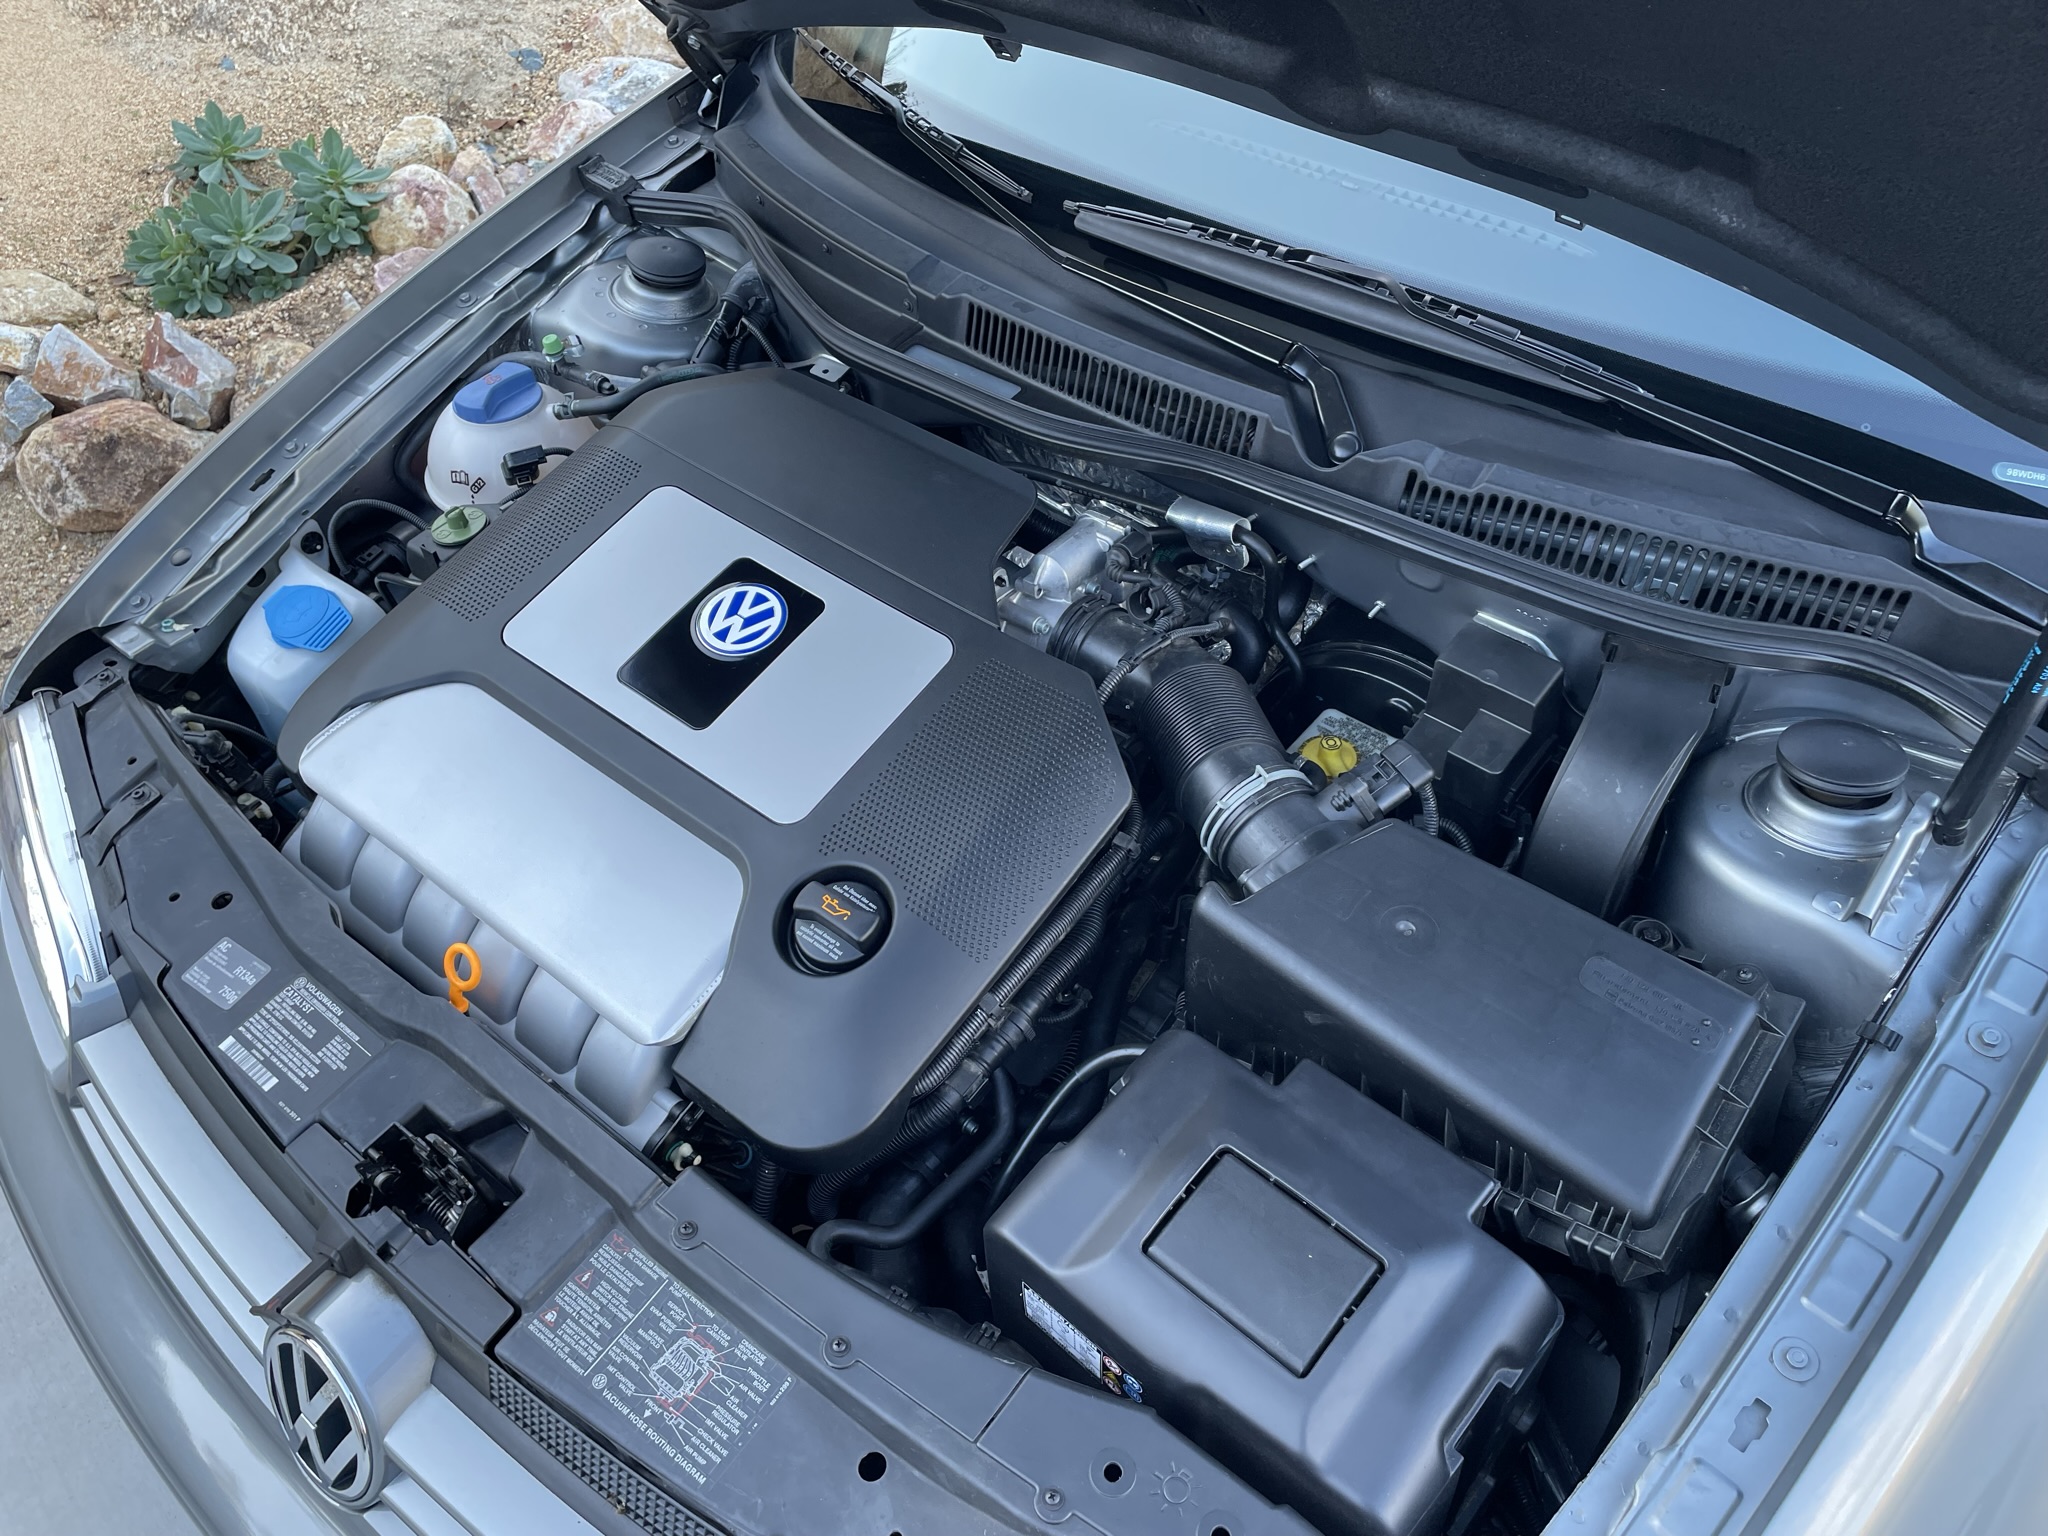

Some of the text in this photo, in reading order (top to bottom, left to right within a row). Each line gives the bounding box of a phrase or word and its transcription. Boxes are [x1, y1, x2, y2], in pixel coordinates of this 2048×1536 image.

[2006, 467, 2048, 481] 9BWDH6
[471, 478, 485, 493] G12
[697, 582, 788, 657] VW
[217, 940, 232, 952] AC
[232, 965, 256, 985] R134a
[218, 984, 238, 1004] 750g
[282, 986, 314, 1013] CATALYST
[305, 982, 343, 1016] VOLKSWAGEN
[589, 1257, 602, 1269] POUR
[598, 1248, 625, 1272] REMPLISSAGE
[626, 1252, 659, 1280] OIL CAN DAMAGE
[630, 1247, 668, 1279] OVERFILLED ENGINE
[600, 1279, 612, 1291] HIGH
[609, 1265, 634, 1287] DANGEREUX
[562, 1285, 577, 1299] HAUTE
[567, 1281, 585, 1298] IGNITION
[668, 1285, 682, 1297] PUMP
[672, 1281, 715, 1318] TO LEAK DETECTION
[554, 1295, 573, 1313] TOUCHER
[558, 1290, 599, 1328] LE MOTEUR AVANT DE
[591, 1289, 628, 1322] BEFORE TOUCHING
[595, 1284, 634, 1319] SWITCH OFF ENGINE
[667, 1300, 686, 1318] SERVICE
[649, 1305, 677, 1329] EVAP PURGE
[669, 1310, 683, 1322] PORT
[532, 1318, 570, 1353] RADIATEUR PEUT SE
[561, 1323, 575, 1336] START
[578, 1339, 588, 1348] ANY
[565, 1318, 603, 1351] RADIATOR FAN MAY
[637, 1328, 660, 1348] MANIFOLD
[647, 1329, 664, 1344] INTAKE
[658, 1321, 673, 1334] VALVE
[706, 1327, 728, 1347] CANISTER
[711, 1323, 731, 1340] TO EVAP
[562, 1333, 588, 1357] VENTILATEUR
[586, 1354, 594, 1363] DE
[618, 1337, 643, 1360] RESERVOIR
[622, 1333, 641, 1351] VACUUM
[556, 1348, 568, 1360] TOUT
[608, 1349, 622, 1363] VALVE
[611, 1345, 640, 1372] AIR CONTROL
[734, 1347, 748, 1361] VALVE
[738, 1343, 764, 1366] VENTILATION
[606, 1364, 636, 1392] IMT CONTROL
[746, 1366, 771, 1388] THROTTLE
[752, 1379, 767, 1392] BODY
[618, 1382, 633, 1397] VALVE
[729, 1395, 739, 1404] AIR
[738, 1383, 762, 1404] AIR VALVE
[644, 1398, 662, 1414] FRONT
[715, 1404, 740, 1427] PRESSURE
[725, 1399, 748, 1420] CLEANER
[704, 1417, 728, 1440] IMT VALVE
[711, 1409, 739, 1435] REGULATOR
[602, 1388, 706, 1484] VACUUM HOSE ROUTING DIAGRAM
[697, 1427, 728, 1456] CHECK VALVE
[683, 1444, 706, 1464] AIR PUMP
[690, 1435, 721, 1464] AIR CLEANER
